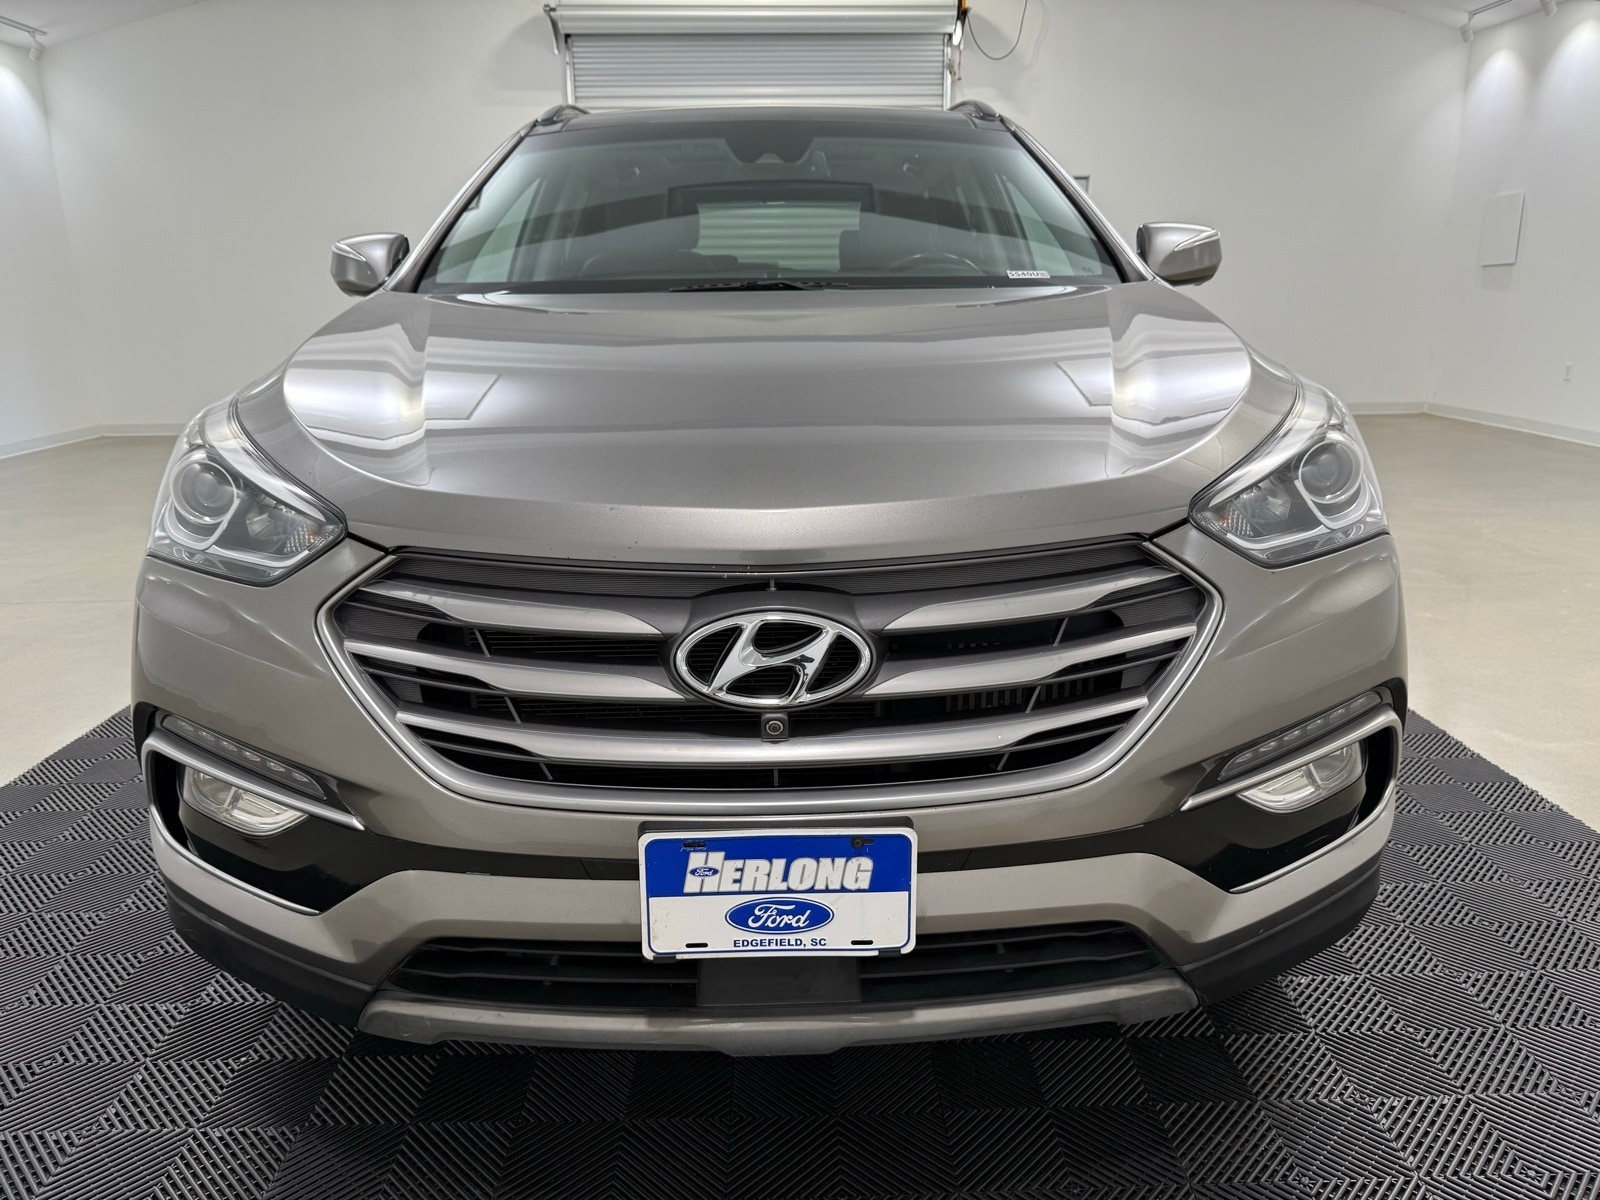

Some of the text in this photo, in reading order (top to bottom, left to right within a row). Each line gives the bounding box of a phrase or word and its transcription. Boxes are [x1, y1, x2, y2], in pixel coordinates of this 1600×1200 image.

[683, 851, 874, 893] HERLONG
[694, 868, 714, 877] Ford
[747, 903, 812, 928] Ford
[733, 938, 827, 948] EDGEFIELD, SC
